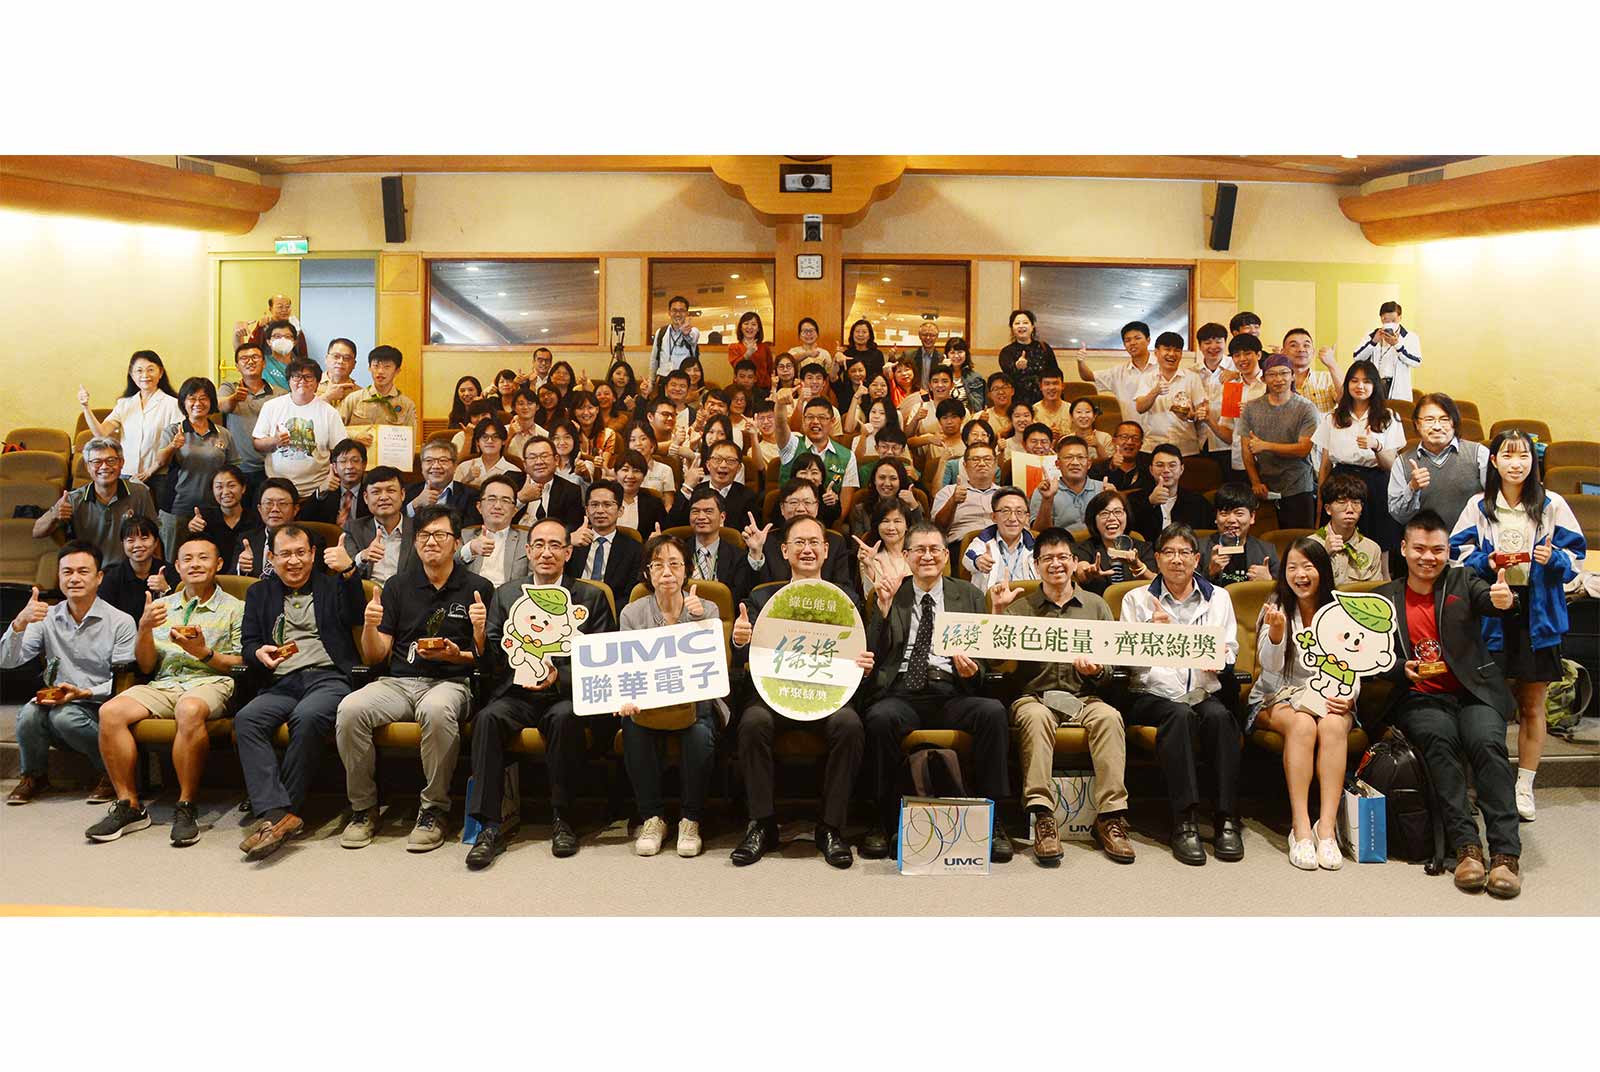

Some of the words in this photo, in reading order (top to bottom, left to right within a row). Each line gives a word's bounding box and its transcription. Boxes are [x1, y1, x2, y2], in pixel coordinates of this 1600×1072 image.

[788, 596, 837, 613] 綠色能量
[579, 629, 717, 668] UMC
[581, 661, 720, 704] 聯華電子
[943, 857, 984, 866] UMC
